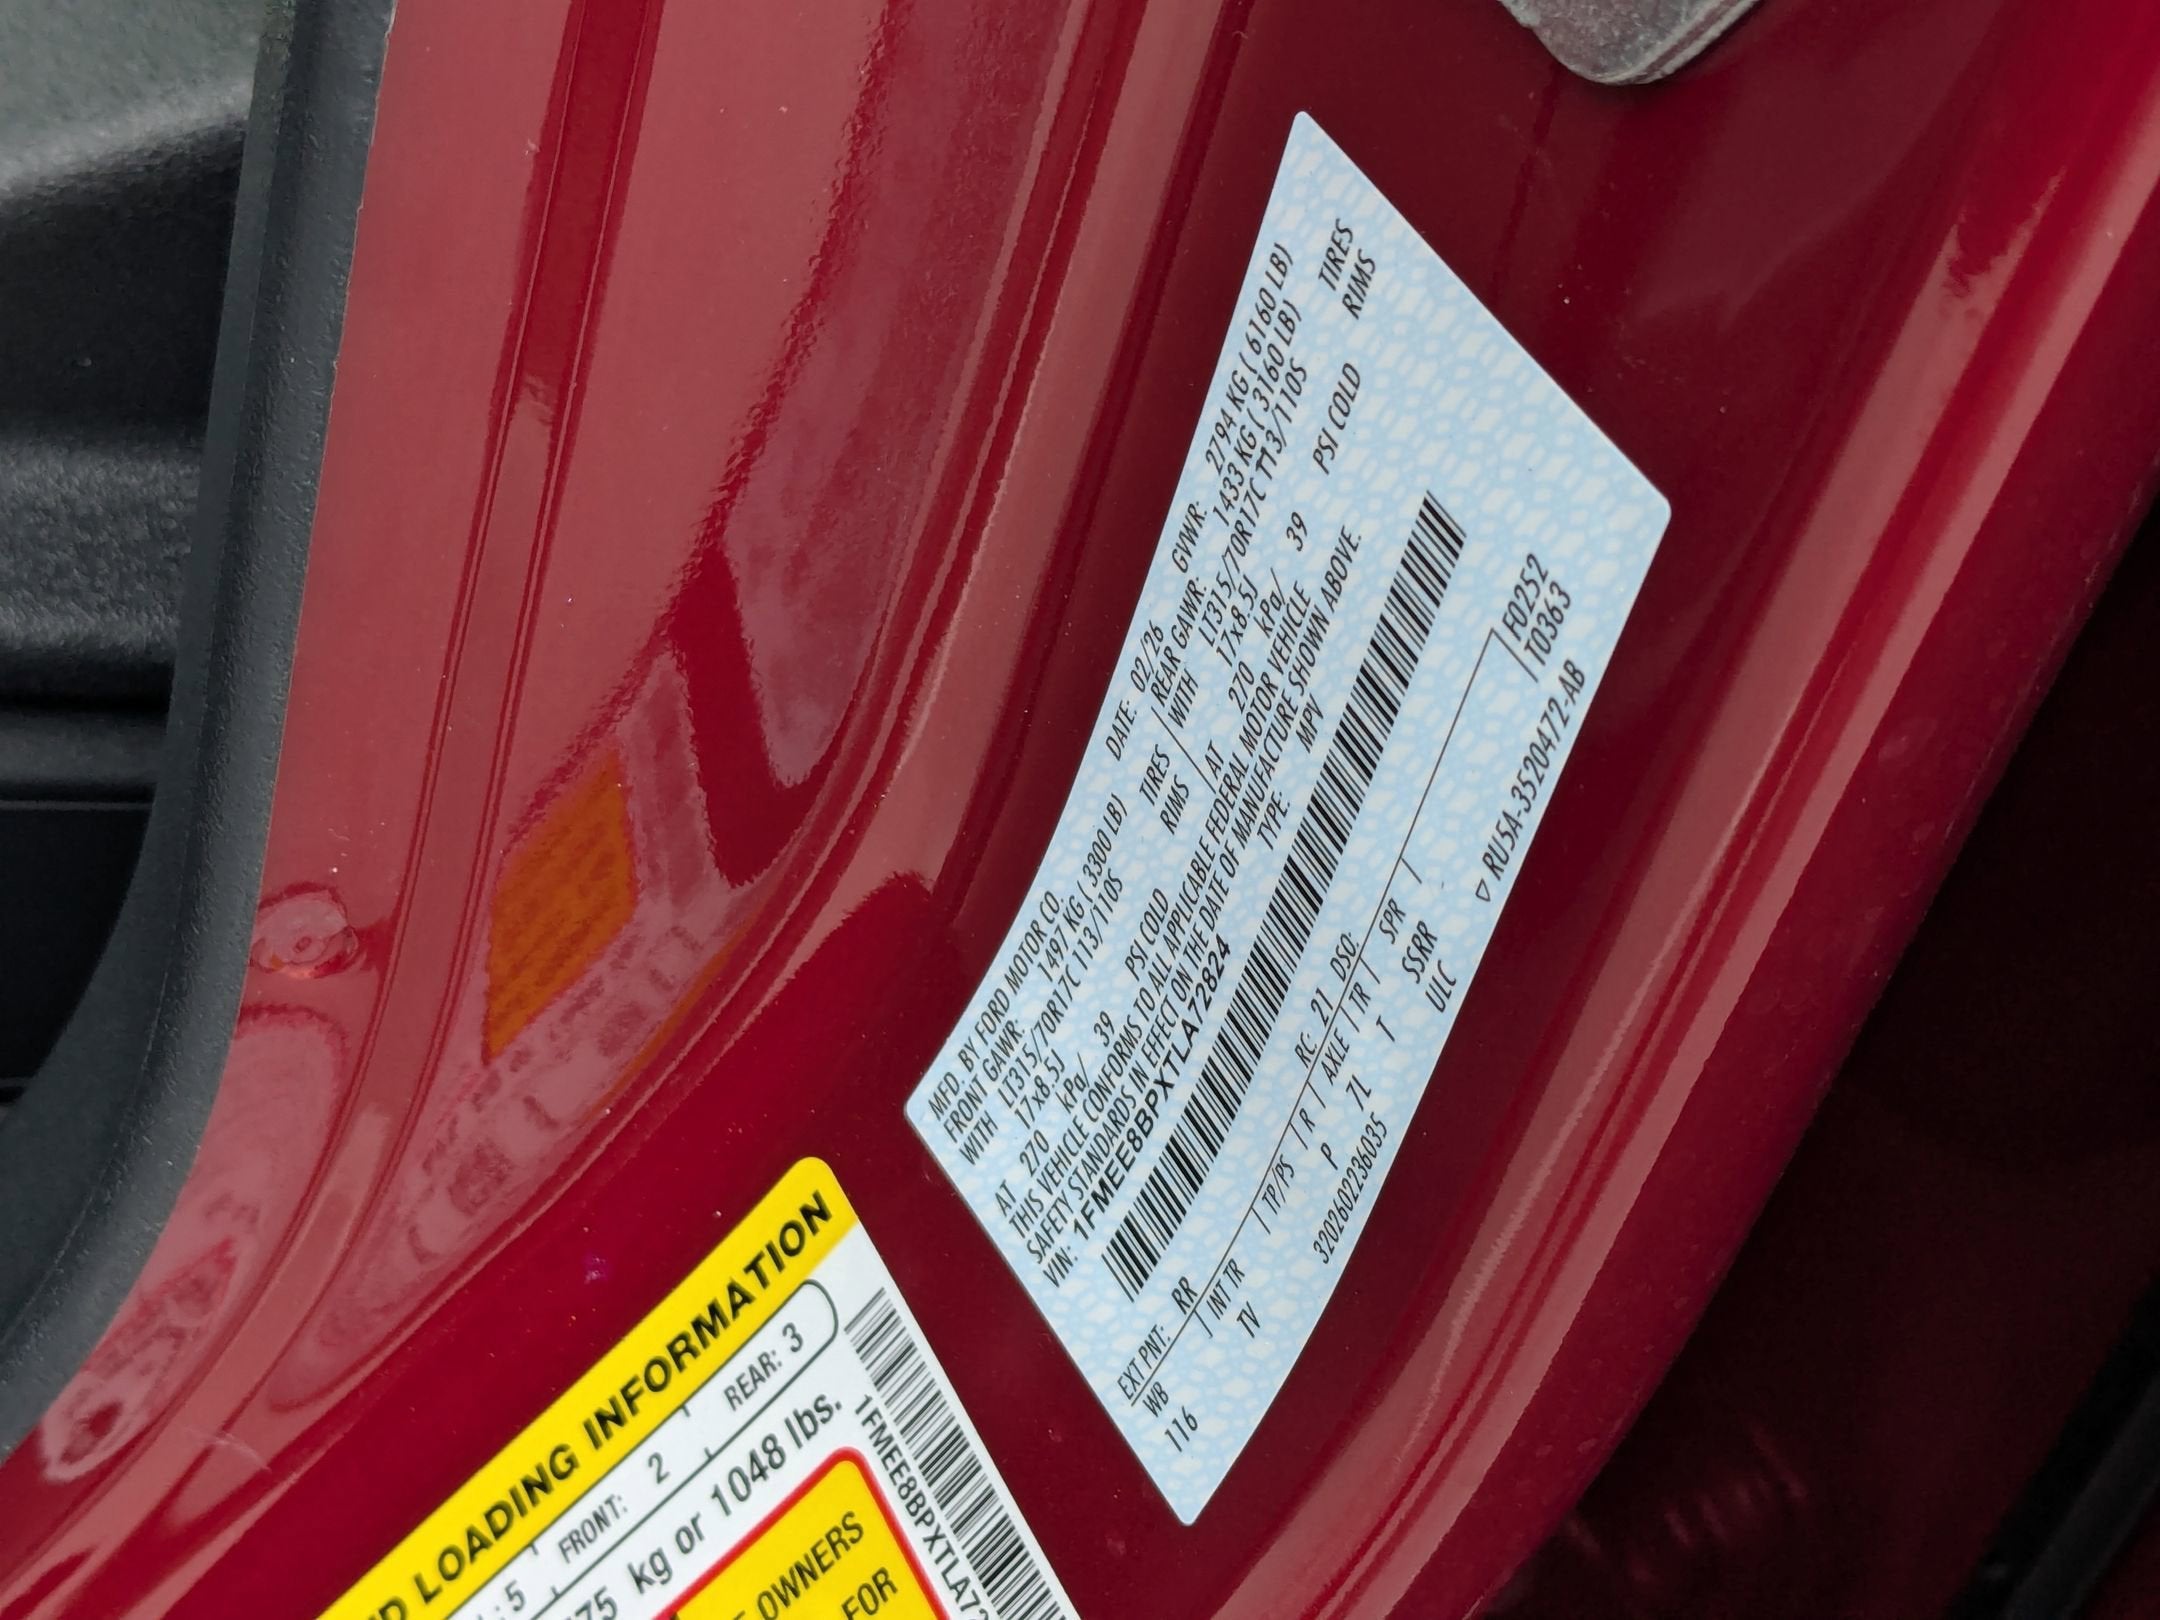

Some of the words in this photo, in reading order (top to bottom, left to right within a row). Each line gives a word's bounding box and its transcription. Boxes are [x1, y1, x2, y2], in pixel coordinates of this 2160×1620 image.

[1150, 645, 1181, 708] REAR
[1171, 576, 1207, 649] GAWR:
[1213, 462, 1244, 527] 1433
[1234, 425, 1257, 467] KG
[1252, 343, 1284, 412] 3160
[1274, 299, 1302, 347] LB)
[1168, 668, 1199, 729] WITH
[1199, 477, 1266, 647] LT315/70R17C
[1318, 218, 1354, 291] TIRES
[1172, 501, 1208, 574] GVWR:
[1205, 407, 1237, 475] 2794
[1226, 369, 1249, 412] KG
[1245, 287, 1276, 355] 6160
[1265, 243, 1294, 290] LB)
[1204, 739, 1224, 781] AT
[1229, 661, 1255, 714] 270
[1253, 568, 1285, 639] kPa/
[1286, 511, 1308, 551] 39
[1312, 427, 1339, 476] PSI
[1328, 362, 1361, 431] COLD
[1216, 574, 1259, 667] 17x8.5J
[1342, 248, 1376, 320] RIMS
[1105, 699, 1137, 761] DATE:
[1130, 620, 1164, 694] 02/26
[1257, 791, 1290, 850] TYPE:
[1296, 693, 1324, 753] MPV
[928, 1072, 965, 1120] MFD.
[958, 1038, 980, 1073] BY
[974, 988, 1010, 1045] FORD
[1004, 920, 1047, 995] MOTOR
[1040, 891, 1064, 925] CO.
[943, 1074, 989, 1143] FRONT
[983, 1019, 1026, 1082] GAWR:
[1038, 926, 1069, 982] 1497
[1063, 895, 1085, 933] KG
[1083, 828, 1113, 888] 3300
[1103, 794, 1127, 835] LB)
[959, 1110, 998, 1166] WITH
[998, 965, 1081, 1108] LT315/70R17C
[1072, 868, 1123, 970] 113/110S
[1139, 744, 1170, 806] TIRES
[995, 1179, 1016, 1217] AT
[1019, 1130, 1050, 1177] 270
[1055, 1051, 1090, 1114] kPa/
[1093, 1010, 1115, 1047] 39
[1125, 939, 1148, 982] PSI
[1140, 888, 1168, 945] COLD
[1009, 1188, 1044, 1239] THIS
[1036, 1115, 1090, 1196] VEHICLE
[1083, 1014, 1142, 1123] CONFORMS
[1133, 987, 1156, 1022] TO
[1148, 952, 1172, 996] ALL
[1163, 836, 1216, 959] APPLICABLE
[1205, 752, 1249, 845] FEDERAL
[1239, 671, 1279, 758] MOTOR
[1267, 580, 1311, 676] VEHICLE
[1014, 1049, 1065, 1129] 17x8.5J
[1160, 774, 1189, 835] RIMS
[1027, 1189, 1074, 1264] SAFETY
[1068, 1085, 1137, 1200] STANDARDS
[1129, 1060, 1150, 1094] IN
[1141, 994, 1179, 1068] EFFECT
[1171, 963, 1193, 1002] ON
[1183, 922, 1209, 970] THE
[1199, 870, 1229, 931] DATE
[1219, 839, 1240, 878] OF
[1231, 689, 1298, 850] MANUFACTURE
[1288, 605, 1330, 697] SHOWN
[1320, 525, 1362, 613] ABOVE.
[1294, 1032, 1318, 1069] RC:
[1311, 987, 1333, 1027] 21
[1330, 932, 1360, 983] DSO:
[1043, 1245, 1078, 1288] VIN:
[1073, 933, 1231, 1240] 1FMEE8BPXTLA72824
[1142, 1380, 1169, 1418] WB
[1206, 1281, 1232, 1321] INT
[1222, 1258, 1246, 1289] TR
[1261, 1154, 1295, 1216] TP/PS
[1299, 1108, 1316, 1134] R
[1321, 1027, 1350, 1087] AXLE
[1348, 981, 1371, 1015] TR
[1379, 897, 1406, 945] SPR
[1164, 1405, 1199, 1452] 116
[1236, 1301, 1261, 1339] TV
[1320, 1142, 1338, 1171] P
[1376, 1015, 1396, 1042] T
[1401, 920, 1438, 985] SSRR
[1313, 1111, 1387, 1265] 3202602236035
[1425, 960, 1457, 1013] ULC
[413, 1443, 580, 1605] LOADING
[582, 1189, 833, 1450] INFORMATION
[505, 1580, 527, 1613] 5
[557, 1494, 629, 1564] FRONT:
[648, 1452, 671, 1484] 2
[723, 1350, 783, 1412] REAR:
[782, 1322, 804, 1354] 3
[566, 1585, 618, 1620] 75
[627, 1547, 673, 1595] kg
[674, 1514, 705, 1555] or
[711, 1433, 786, 1517] 1048
[784, 1393, 843, 1449] lbs.
[1117, 1357, 1145, 1400] EXT
[1138, 1324, 1172, 1370] PNT:
[1171, 1275, 1198, 1316] RR
[756, 1511, 864, 1620] OWNERS
[841, 1567, 898, 1620] FOR
